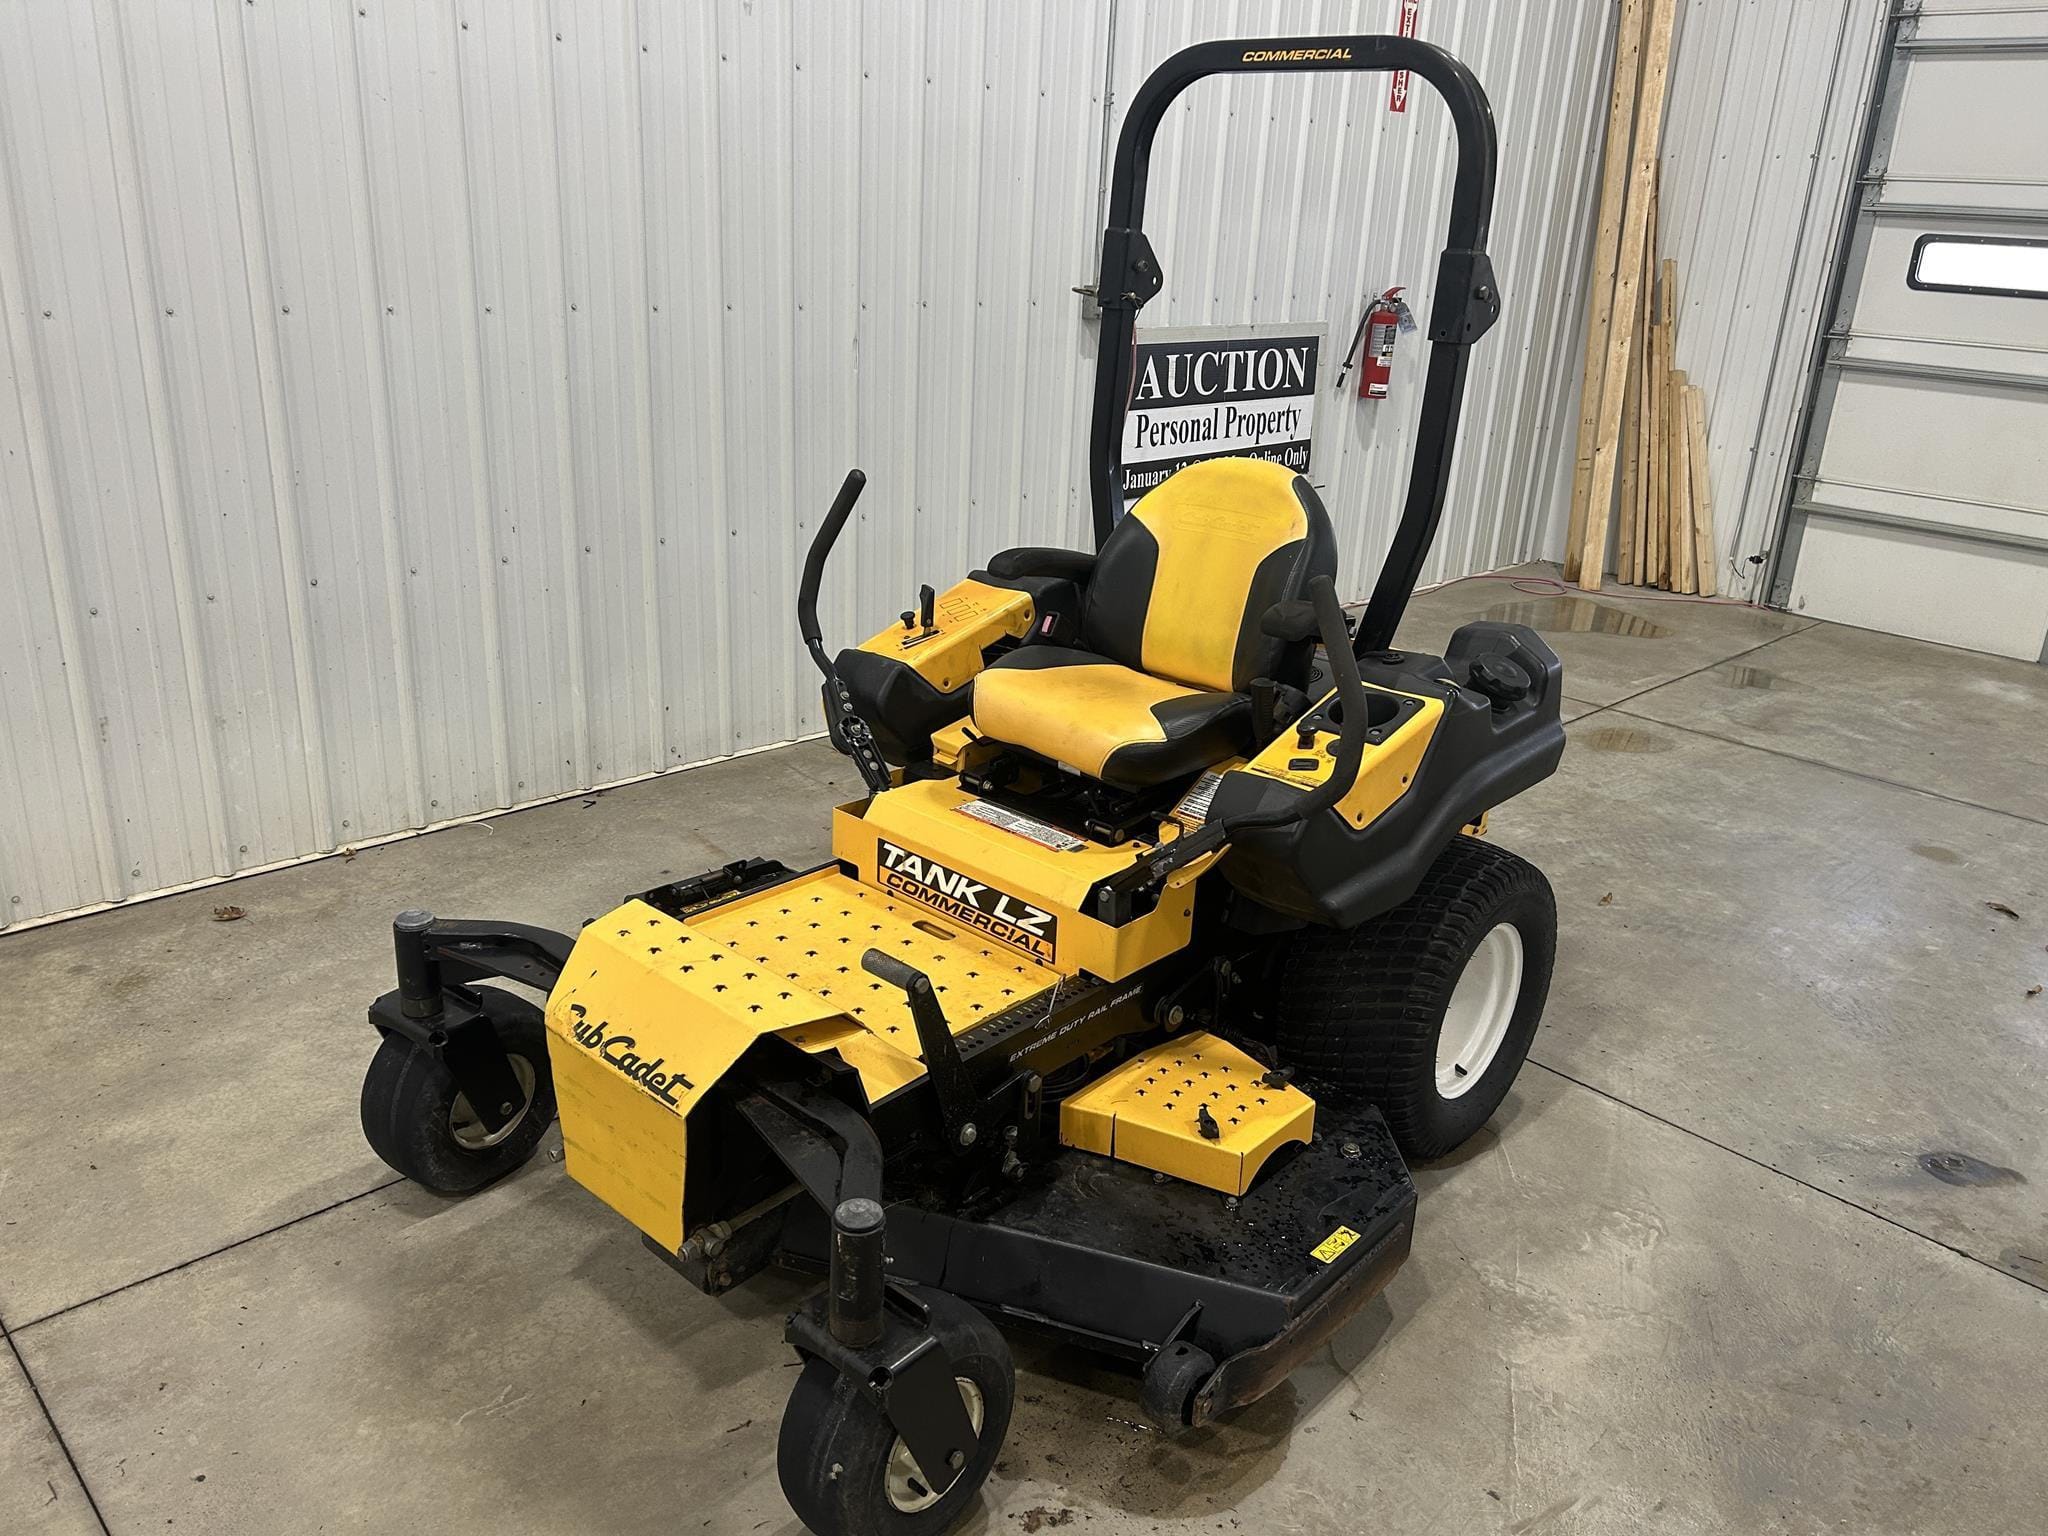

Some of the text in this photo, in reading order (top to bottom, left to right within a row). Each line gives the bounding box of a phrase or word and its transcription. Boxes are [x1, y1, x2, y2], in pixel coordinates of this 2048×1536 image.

[1242, 48, 1352, 62] COMMERCIAL
[1135, 347, 1309, 400] AUCTION
[1135, 403, 1302, 449] Personal Property
[1250, 450, 1282, 464] line
[1284, 446, 1309, 469] Only
[883, 843, 1052, 937] TANK LZ
[886, 873, 1046, 957] COMMERCIAL
[1009, 985, 1142, 1062] EXTREME DUTY RAIL FRAME
[600, 1036, 694, 1106] Cadet
